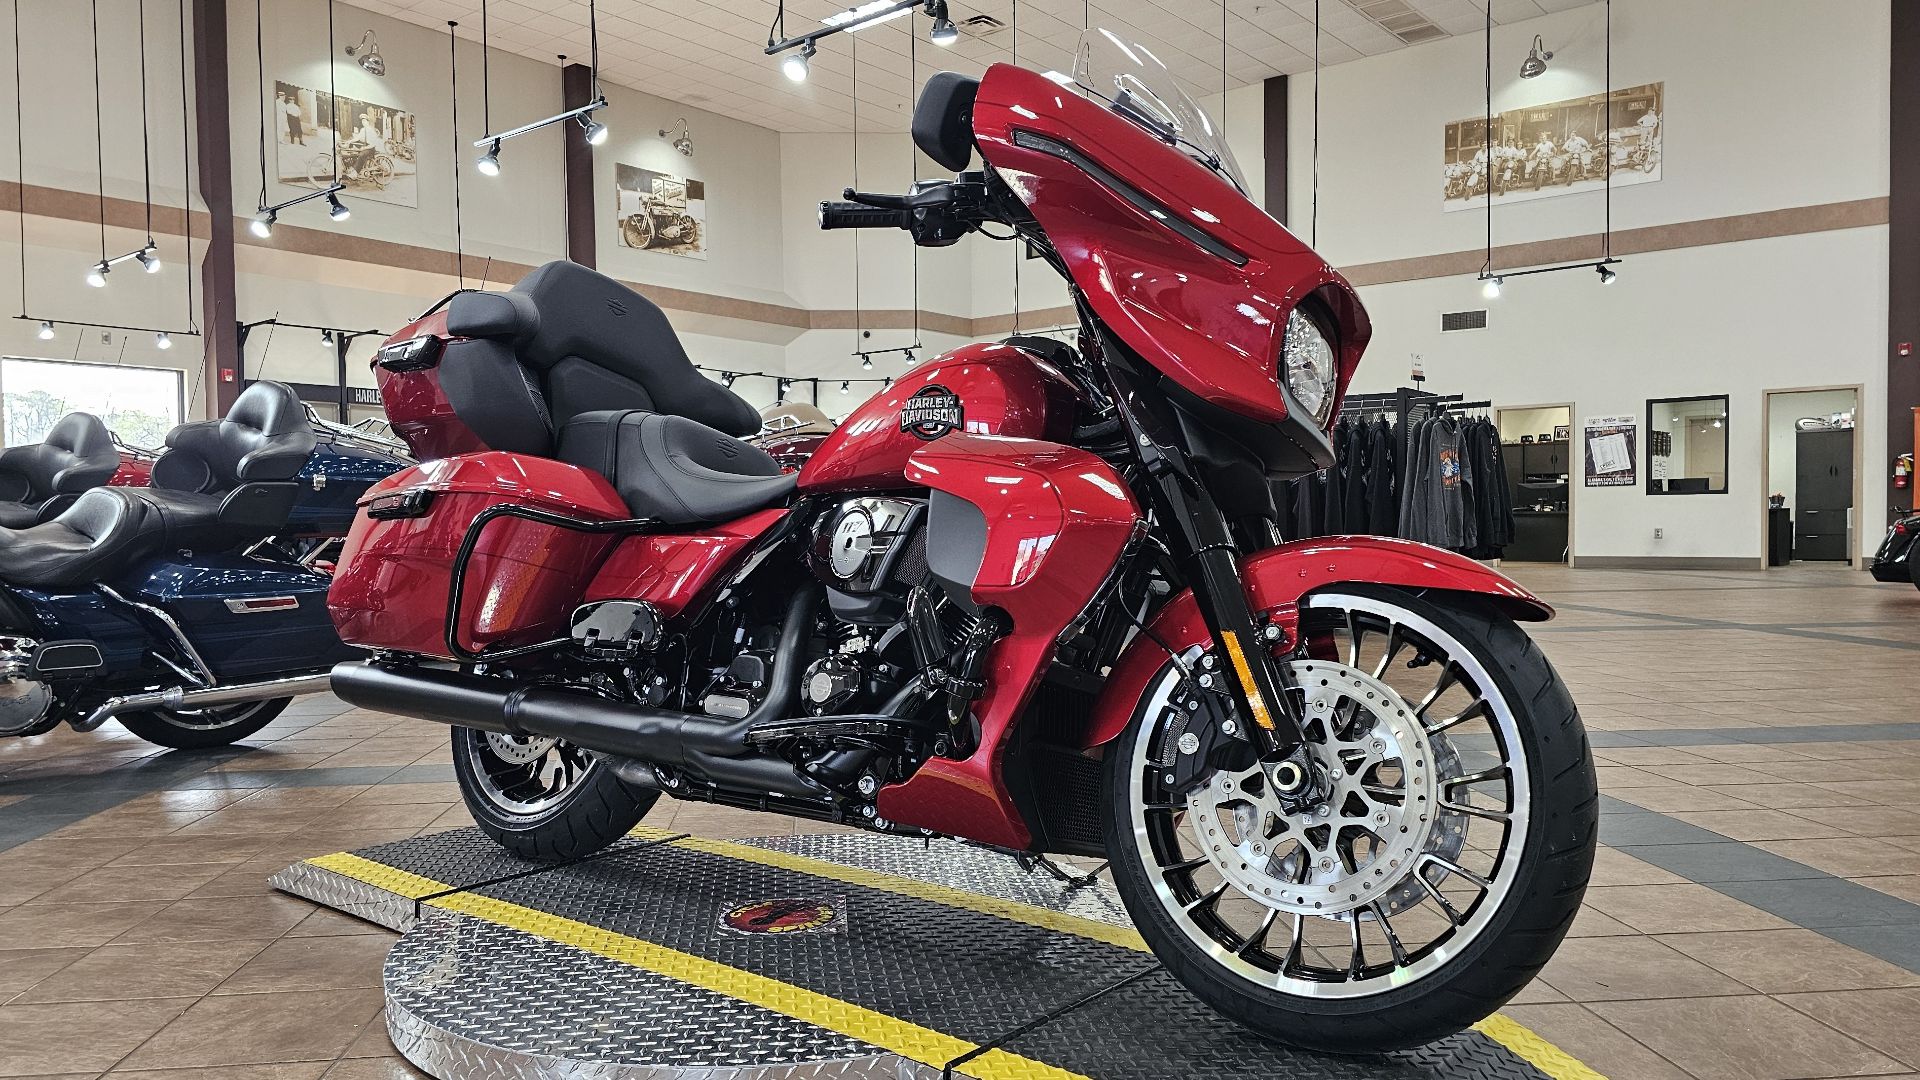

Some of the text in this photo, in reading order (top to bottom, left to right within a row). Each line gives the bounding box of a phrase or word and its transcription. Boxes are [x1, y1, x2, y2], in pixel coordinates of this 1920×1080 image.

[906, 397, 953, 409] HARLEY-
[901, 408, 958, 427] DAVIDSON
[841, 520, 865, 534] 117
